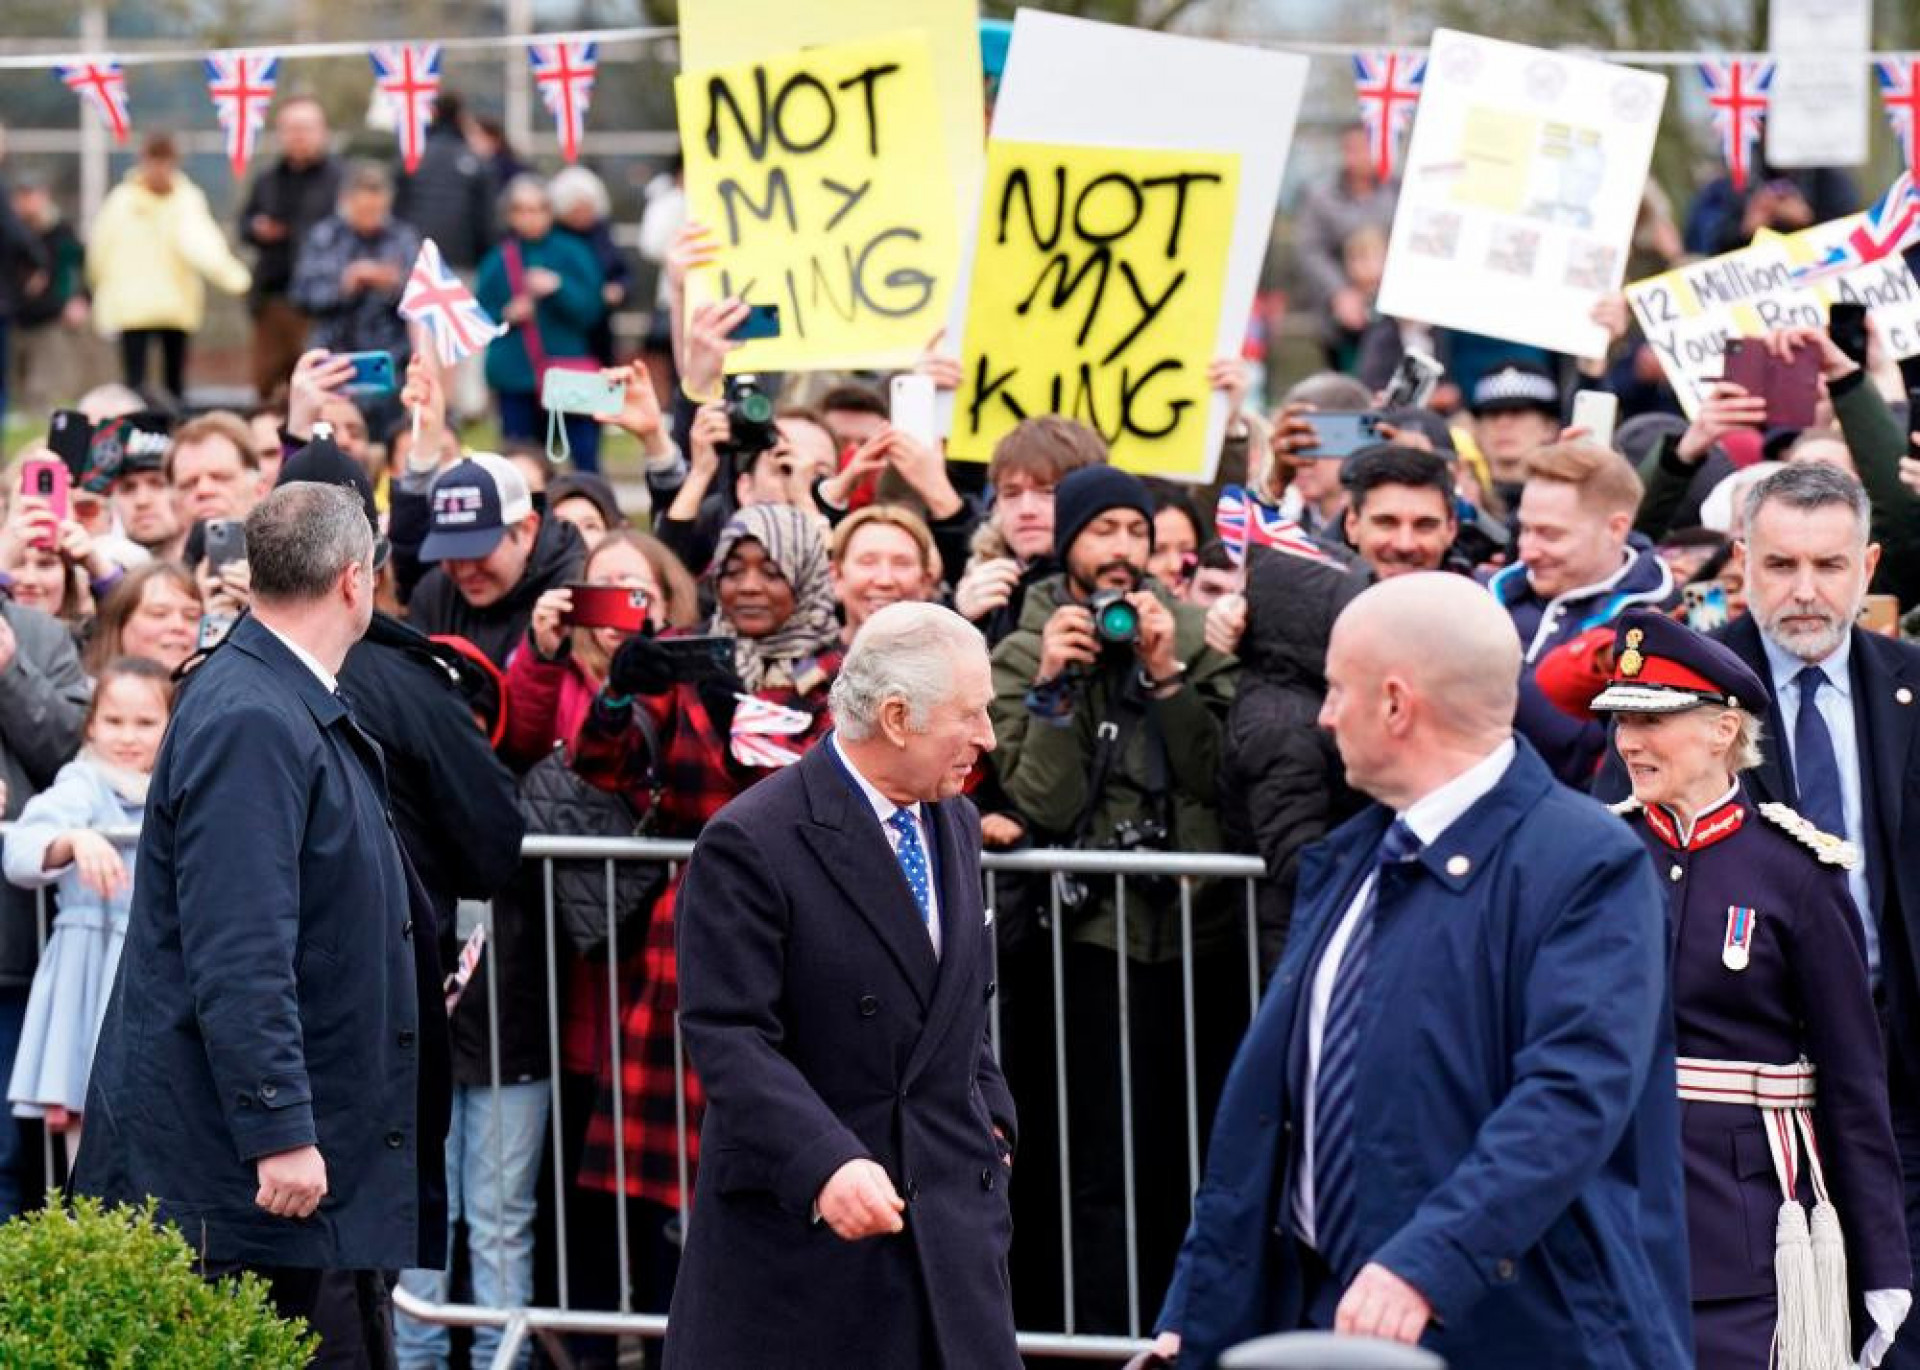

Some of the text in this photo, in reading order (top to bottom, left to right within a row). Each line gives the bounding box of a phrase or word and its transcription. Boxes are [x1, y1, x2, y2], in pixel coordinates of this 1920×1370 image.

[704, 63, 901, 161] NOT
[716, 166, 873, 247] MY
[997, 166, 1222, 259] NOT
[1016, 246, 1187, 367] MY
[1636, 260, 1792, 326] 12 Million
[969, 355, 1195, 447] KING
